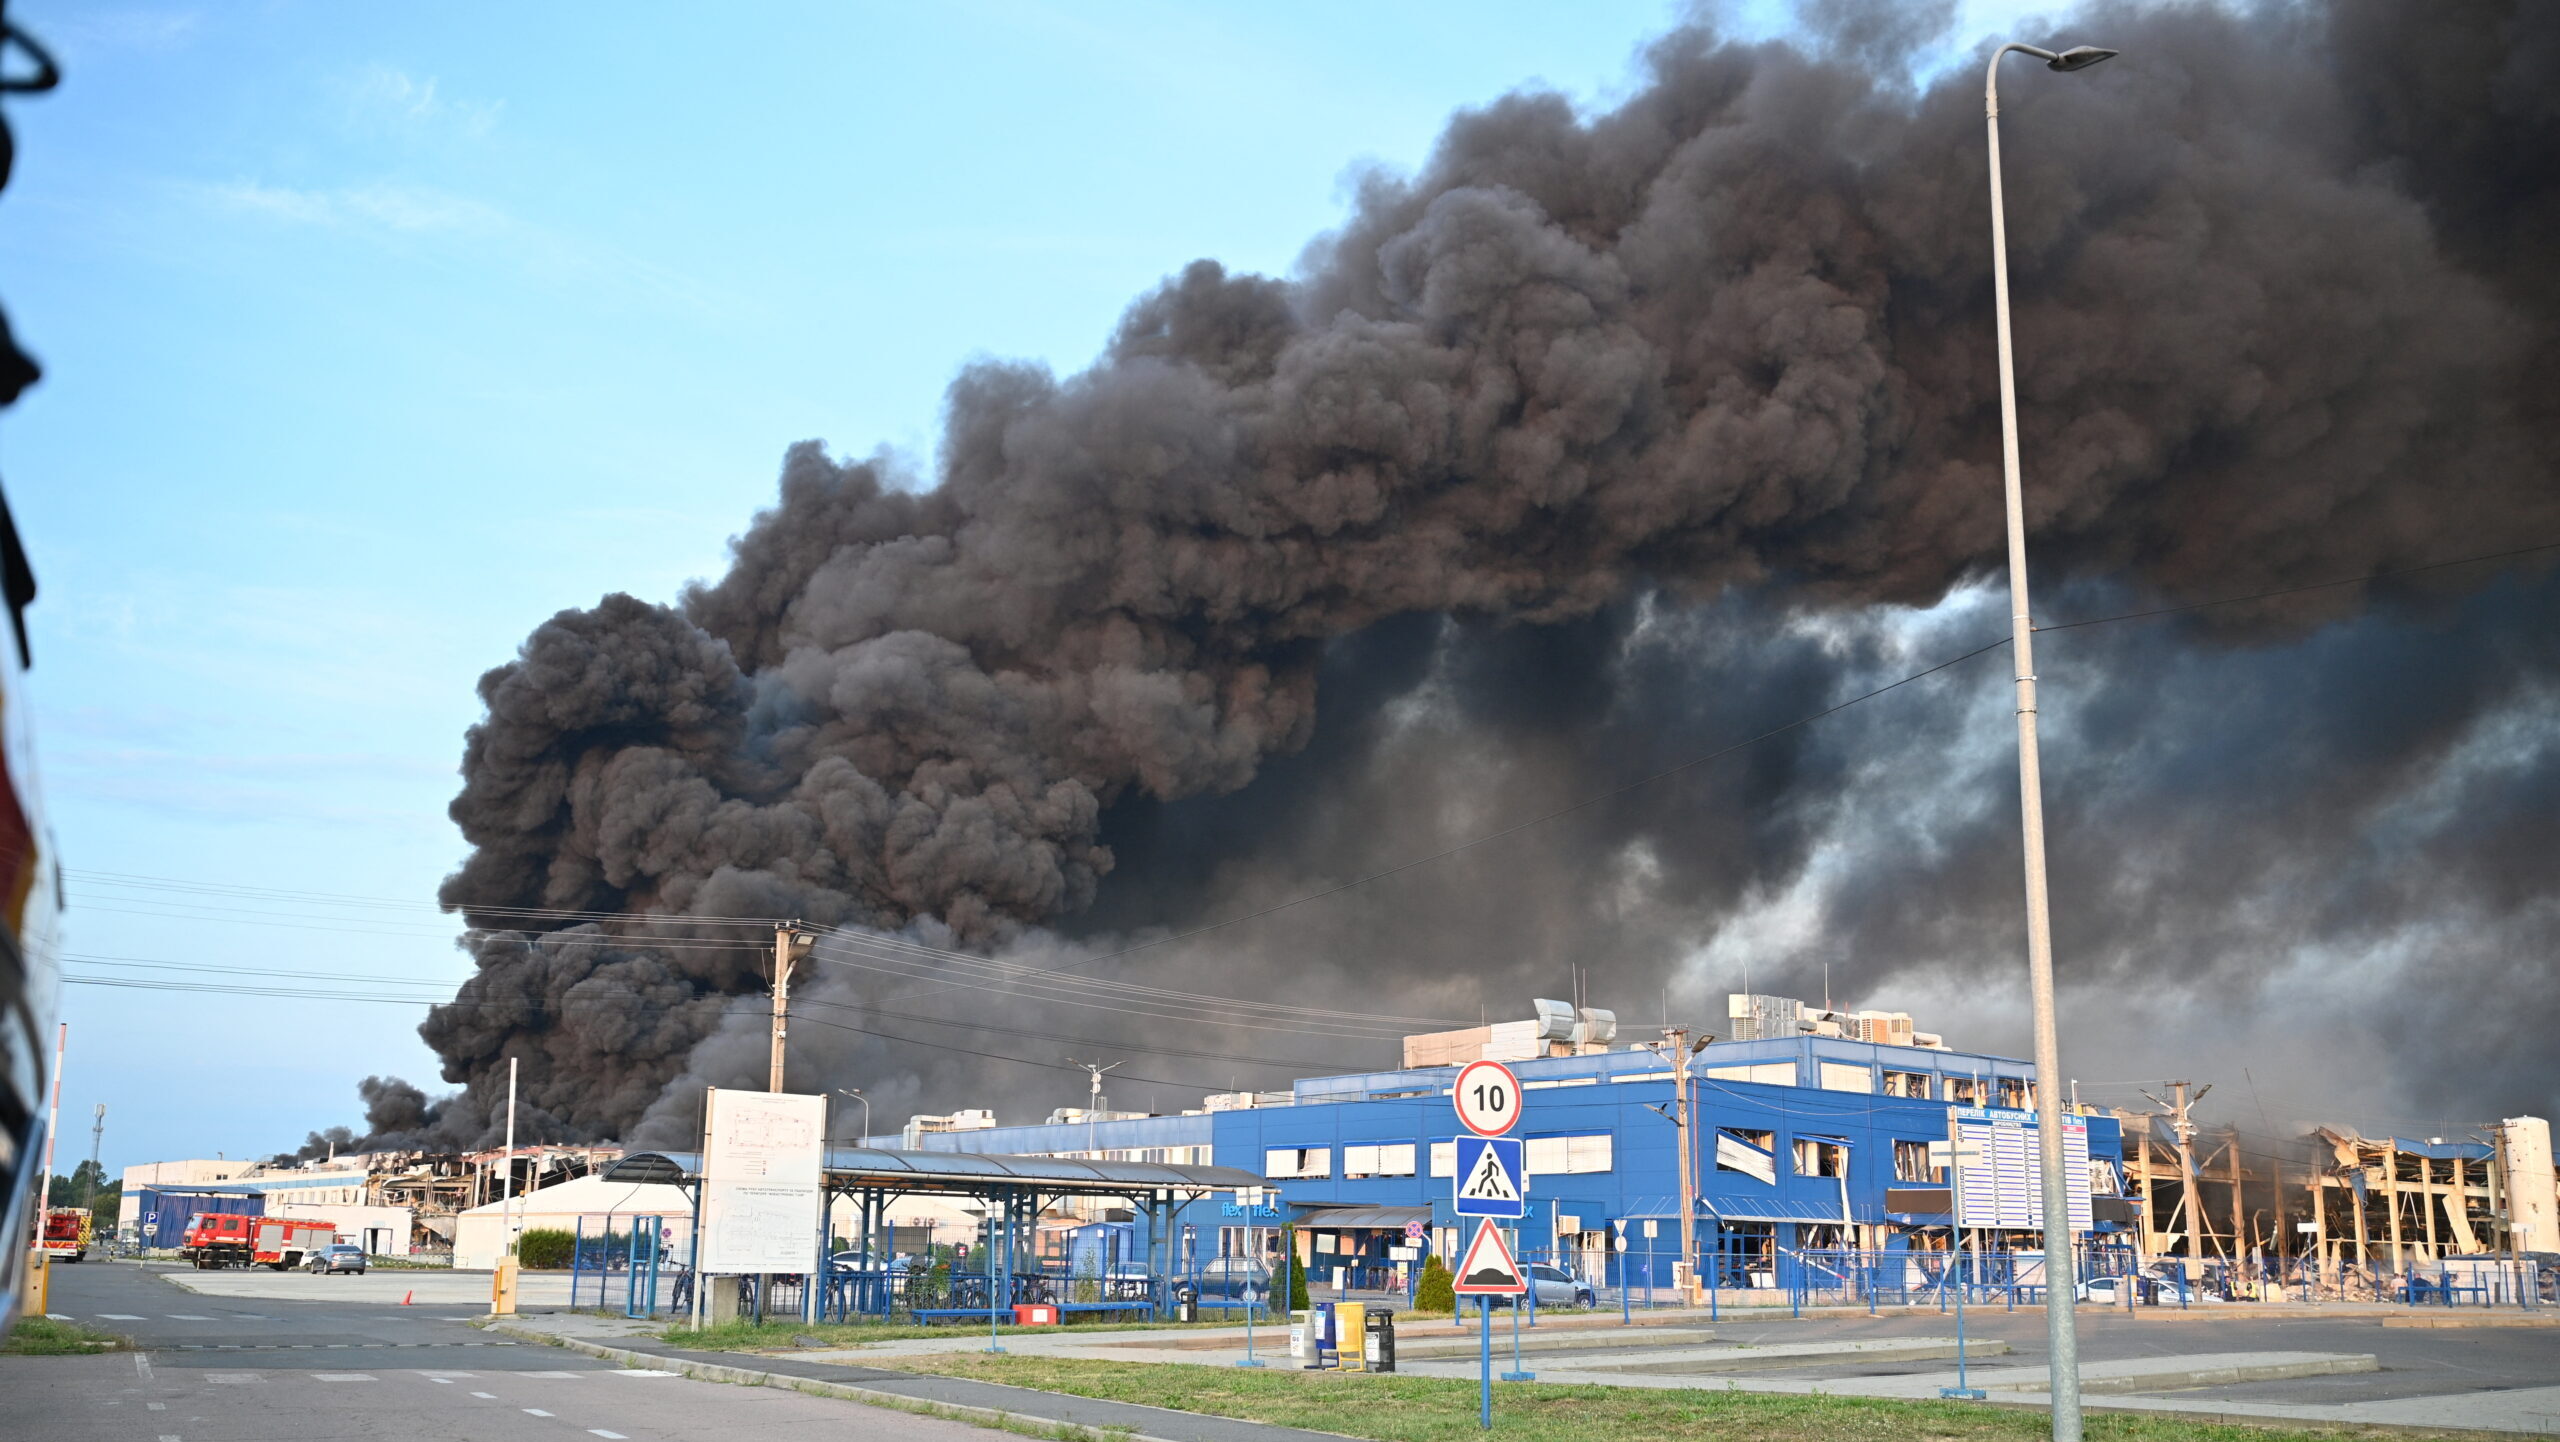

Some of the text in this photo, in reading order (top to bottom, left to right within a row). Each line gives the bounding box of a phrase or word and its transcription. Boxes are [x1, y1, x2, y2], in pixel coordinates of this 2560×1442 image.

[1473, 1084, 1505, 1112] 10
[1957, 1107, 1985, 1118] ПЕРЕЛІК
[1989, 1109, 2032, 1121] АВТОБУСНИХ
[1221, 1202, 1242, 1217] flex
[148, 1213, 156, 1223] P
